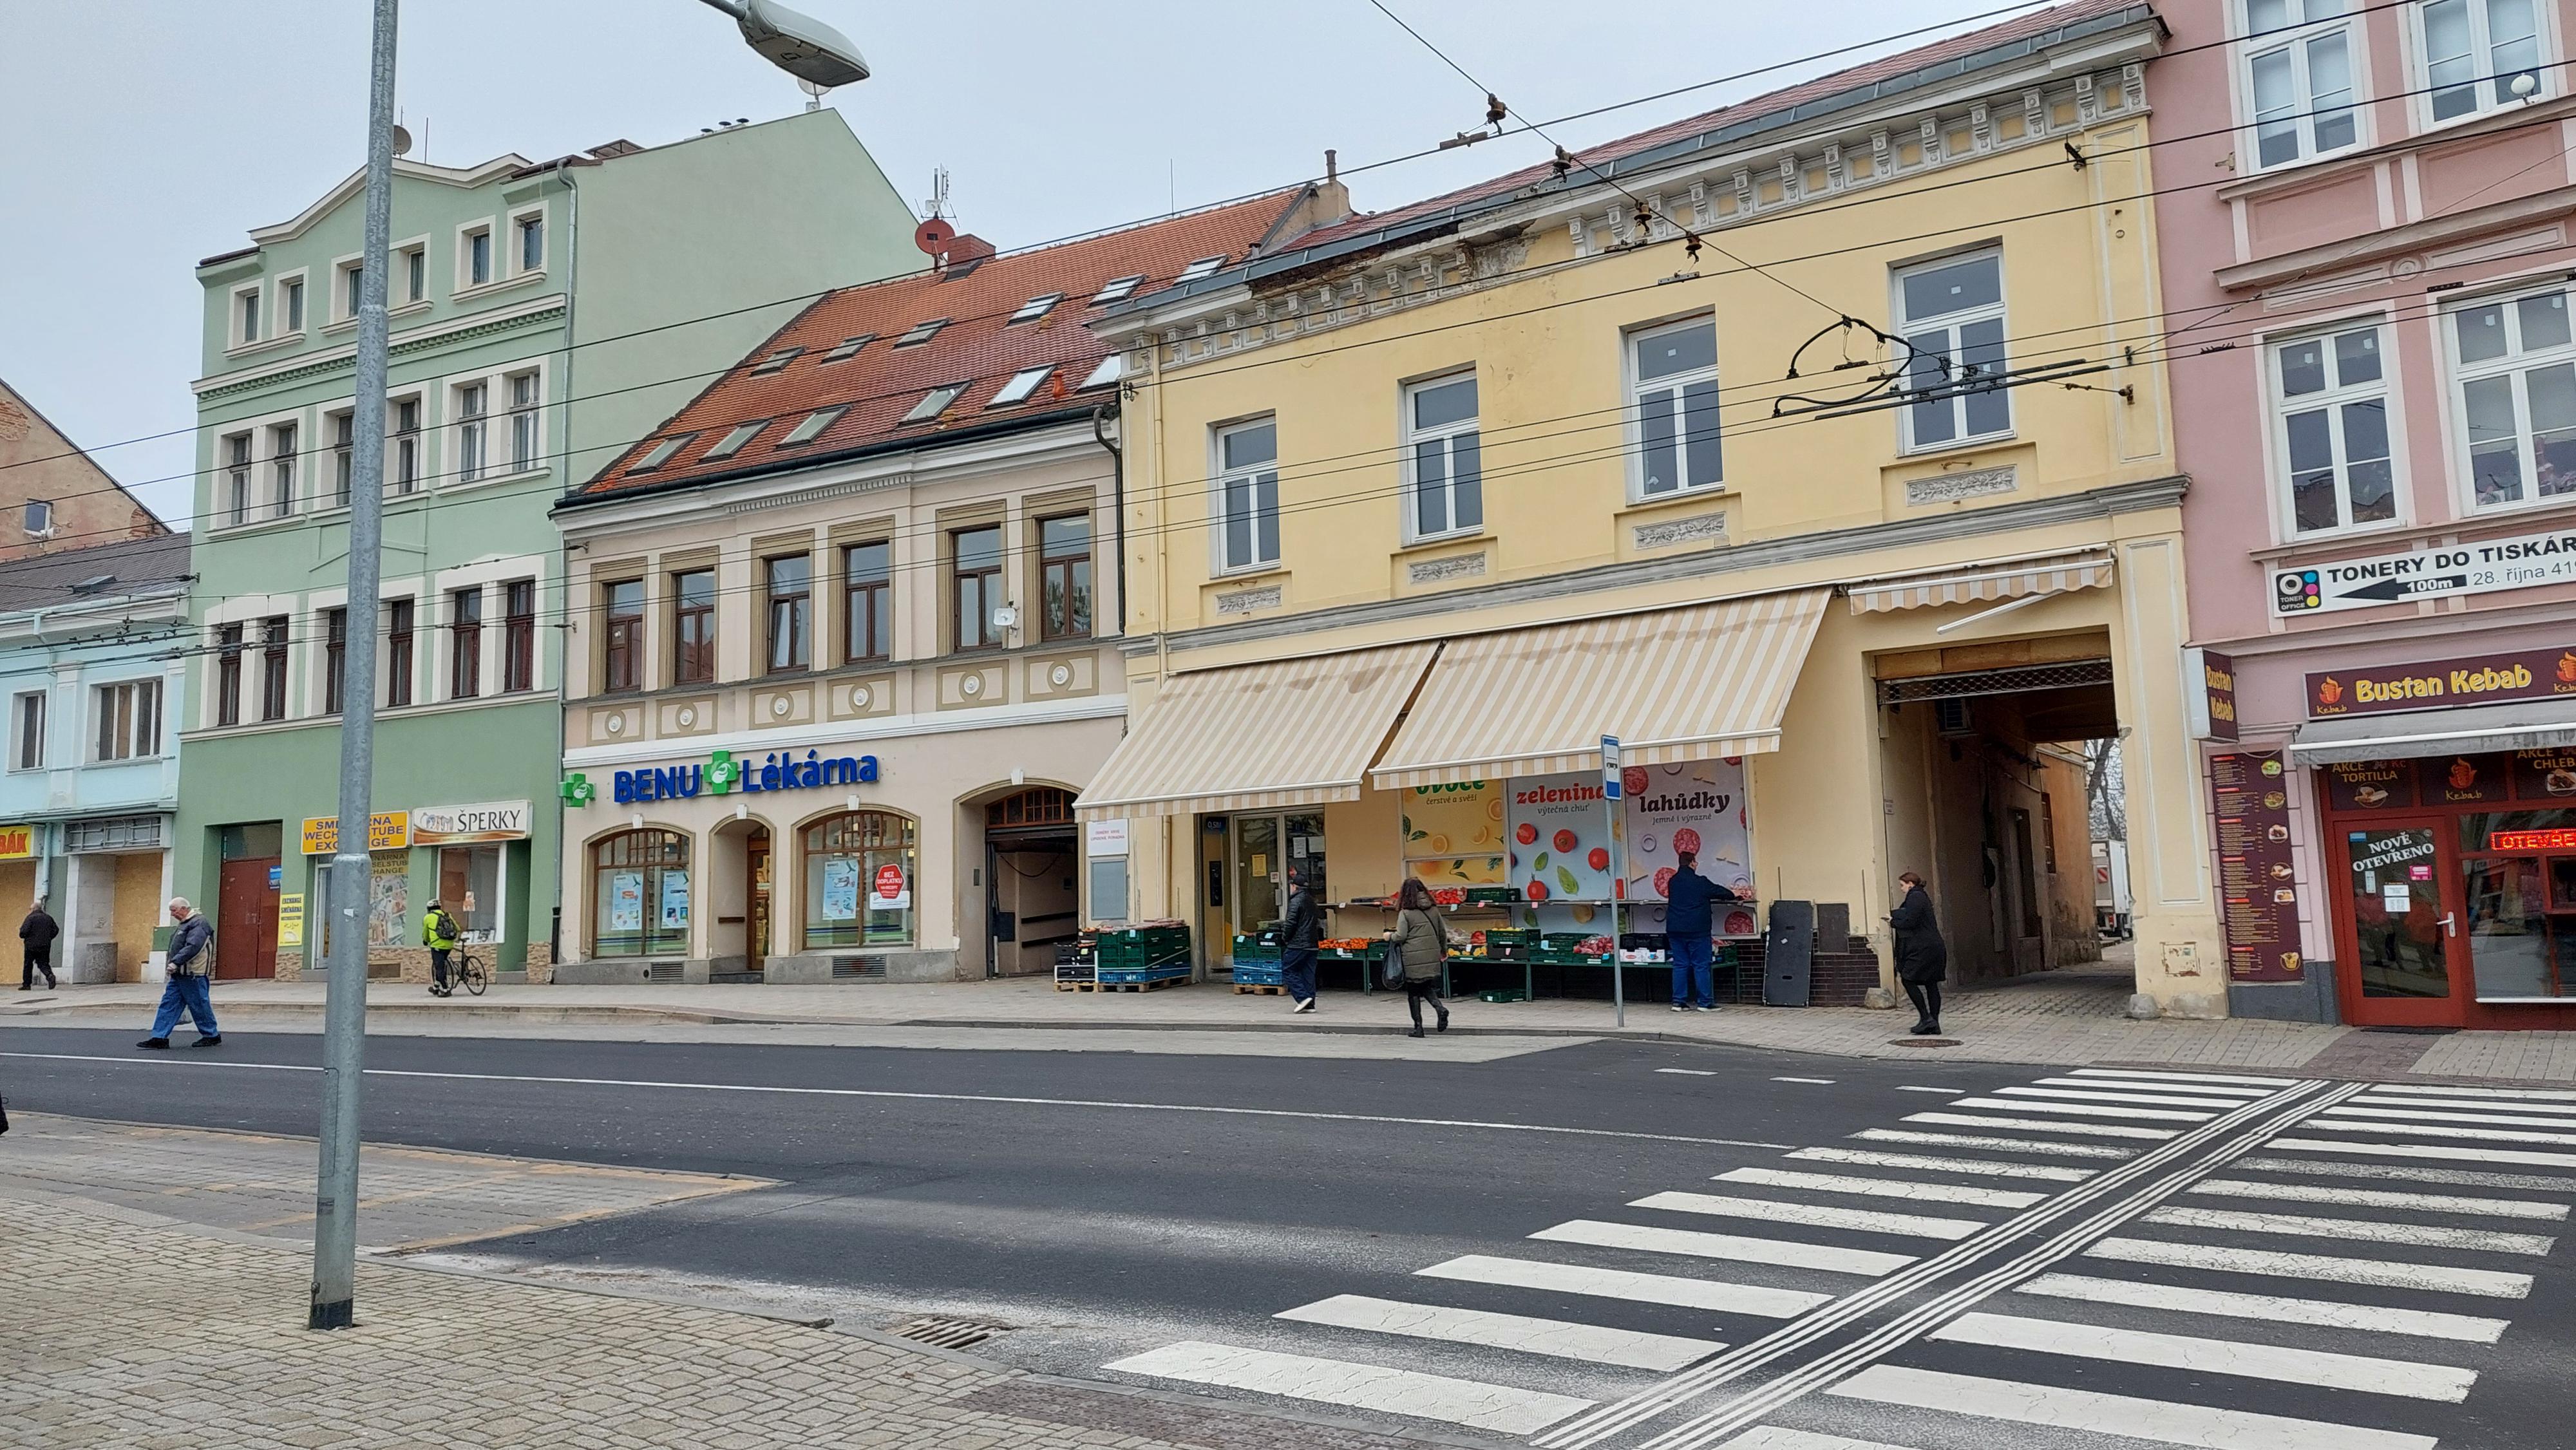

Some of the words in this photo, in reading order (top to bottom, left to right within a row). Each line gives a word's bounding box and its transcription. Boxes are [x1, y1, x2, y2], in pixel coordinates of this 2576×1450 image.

[2327, 557, 2426, 583] TONERY
[2436, 551, 2470, 570] DO
[2479, 535, 2576, 564] TISKÁR
[2473, 572, 2500, 587] 28.
[2506, 567, 2545, 583] října
[2551, 561, 2576, 575] 41
[2407, 579, 2454, 592] 100m
[2205, 664, 2232, 692] Bustan
[2355, 676, 2443, 703] Bustan
[2450, 664, 2532, 693] Kebab
[2210, 696, 2234, 721] Kebab
[2316, 705, 2347, 714] Kebab
[2517, 748, 2554, 758] AKCE
[2332, 762, 2365, 773] AKCE
[2533, 758, 2576, 769] CHLEB
[614, 764, 701, 803] BENU
[742, 749, 878, 793] Lékárna
[2341, 770, 2398, 782] TORTILLA
[1426, 796, 1451, 805] čerstvé
[1459, 794, 1477, 803] svěží
[1517, 783, 1604, 804] zelenina
[2446, 790, 2483, 800] Kebab
[1639, 791, 1730, 814] lahůdky
[1537, 805, 1568, 816] výtečná
[1571, 804, 1589, 812] chuť
[316, 816, 392, 830] SMNA
[457, 809, 521, 832] ŠPERKY
[305, 825, 404, 840] WECHTUBE
[316, 838, 390, 851] EXCGE
[2368, 831, 2412, 854] NOVĚ
[373, 852, 405, 862] NÁRNA
[2352, 843, 2434, 872] OTEVŘENO
